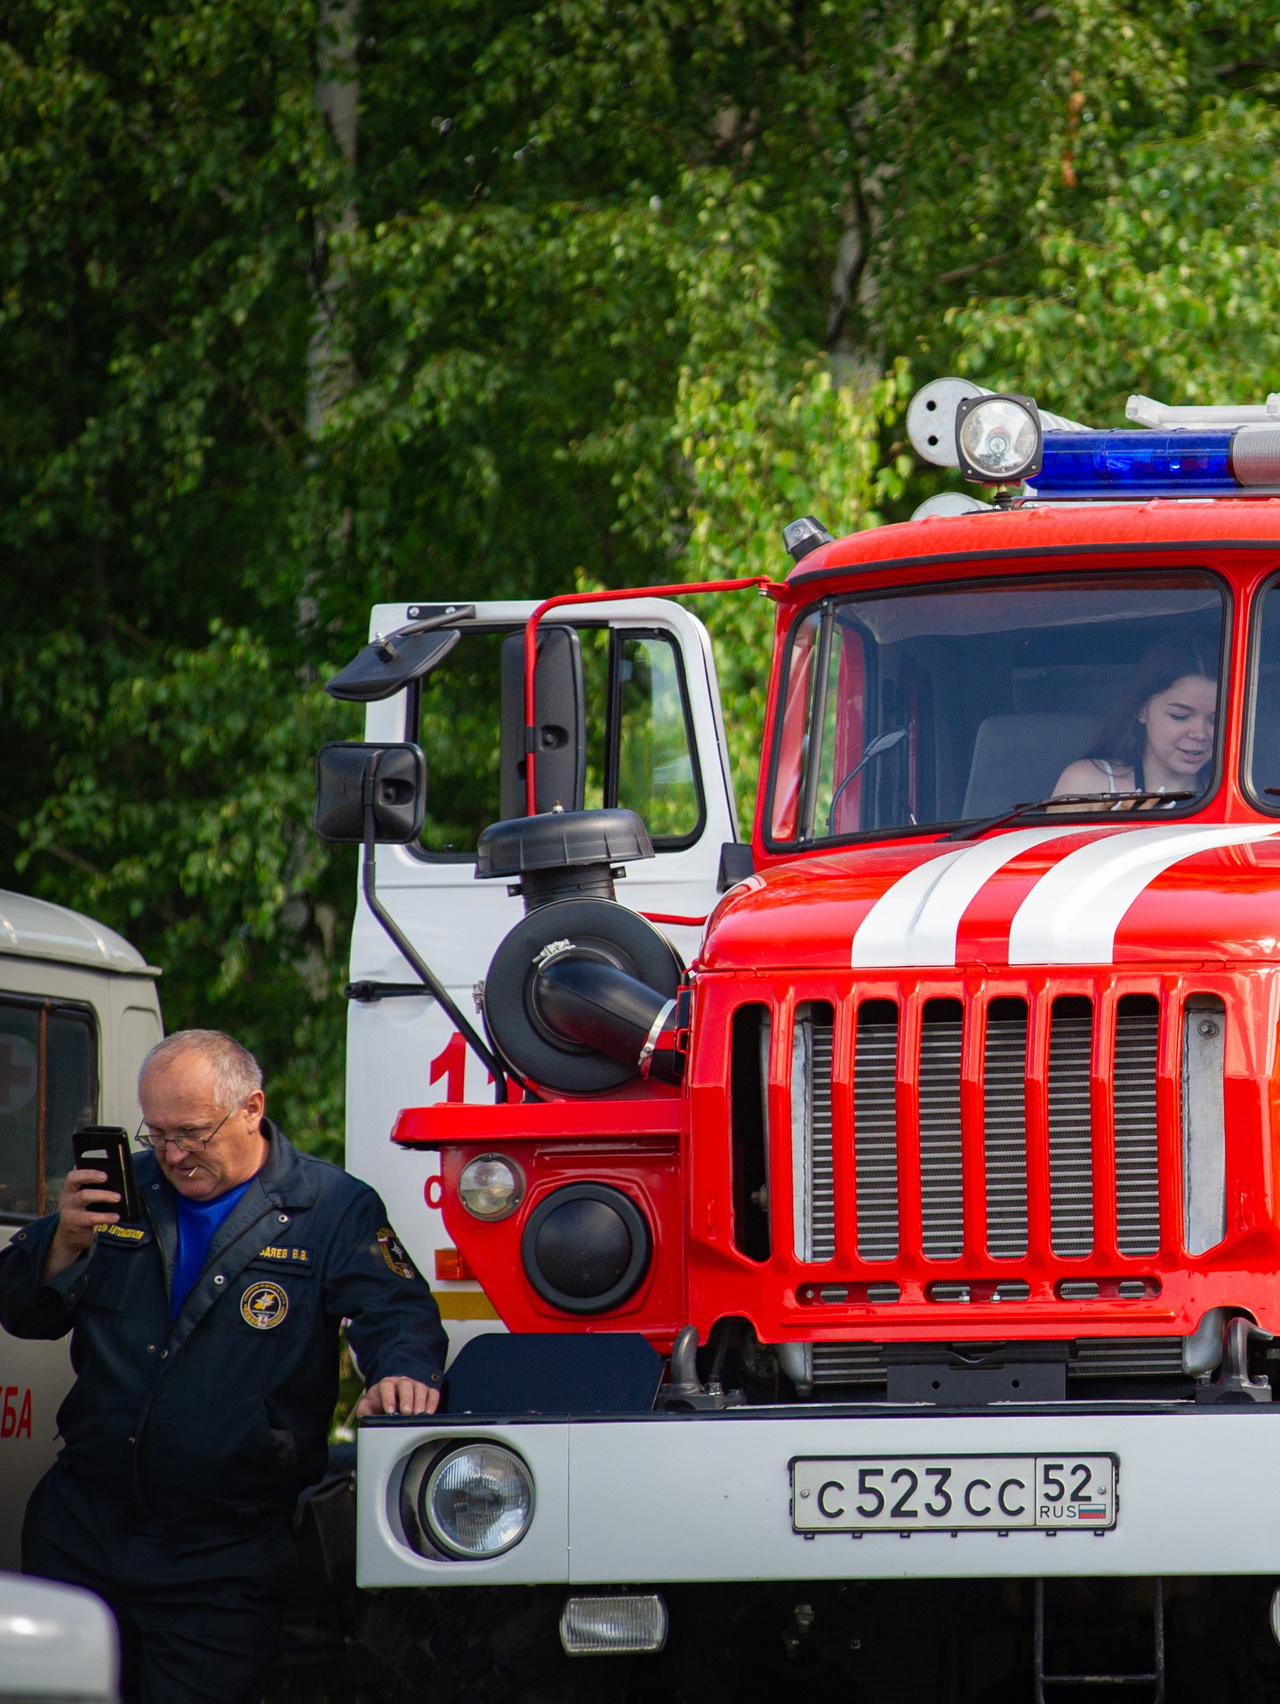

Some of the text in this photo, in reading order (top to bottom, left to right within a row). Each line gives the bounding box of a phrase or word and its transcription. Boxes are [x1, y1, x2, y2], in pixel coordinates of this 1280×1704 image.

[0, 1386, 32, 1439] БА
[816, 1463, 1093, 1519] С523СС 52
[1039, 1504, 1077, 1520] RUS
